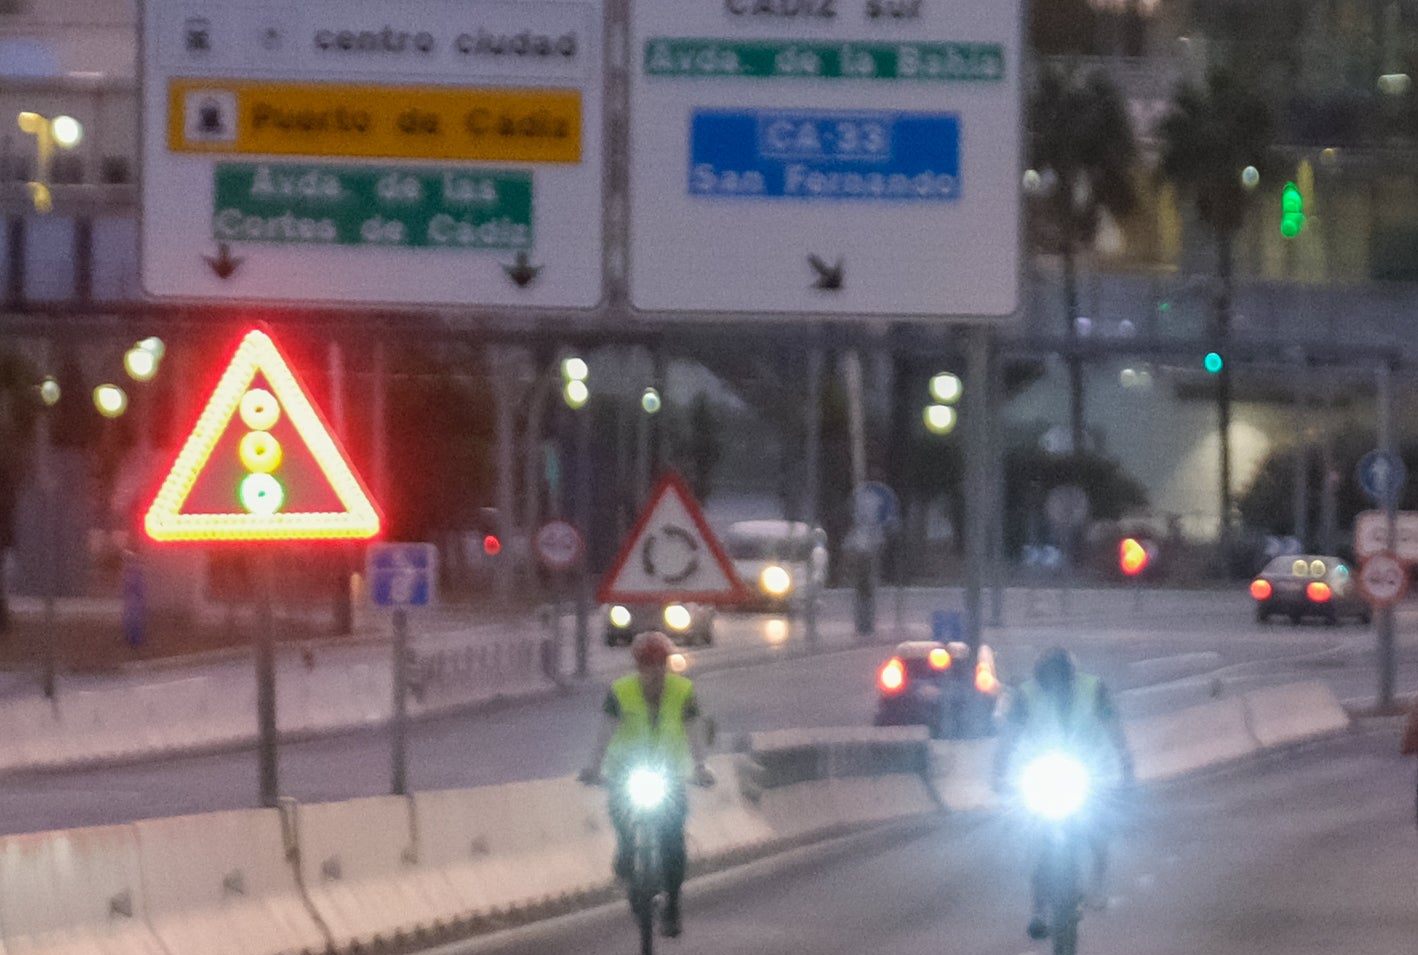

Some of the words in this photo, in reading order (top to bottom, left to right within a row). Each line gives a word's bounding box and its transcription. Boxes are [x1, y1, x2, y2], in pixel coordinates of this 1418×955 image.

[313, 26, 435, 53] centro
[453, 28, 577, 56] ciudad
[774, 47, 821, 75] de
[839, 44, 876, 76] la
[251, 102, 372, 134] Puerto
[396, 108, 440, 135] de
[766, 120, 886, 152] CA-33
[376, 170, 422, 199] de
[442, 170, 498, 202] las
[693, 163, 767, 194] San
[783, 166, 960, 198] Fernando
[214, 207, 338, 240] Cortes
[359, 211, 406, 242] de
